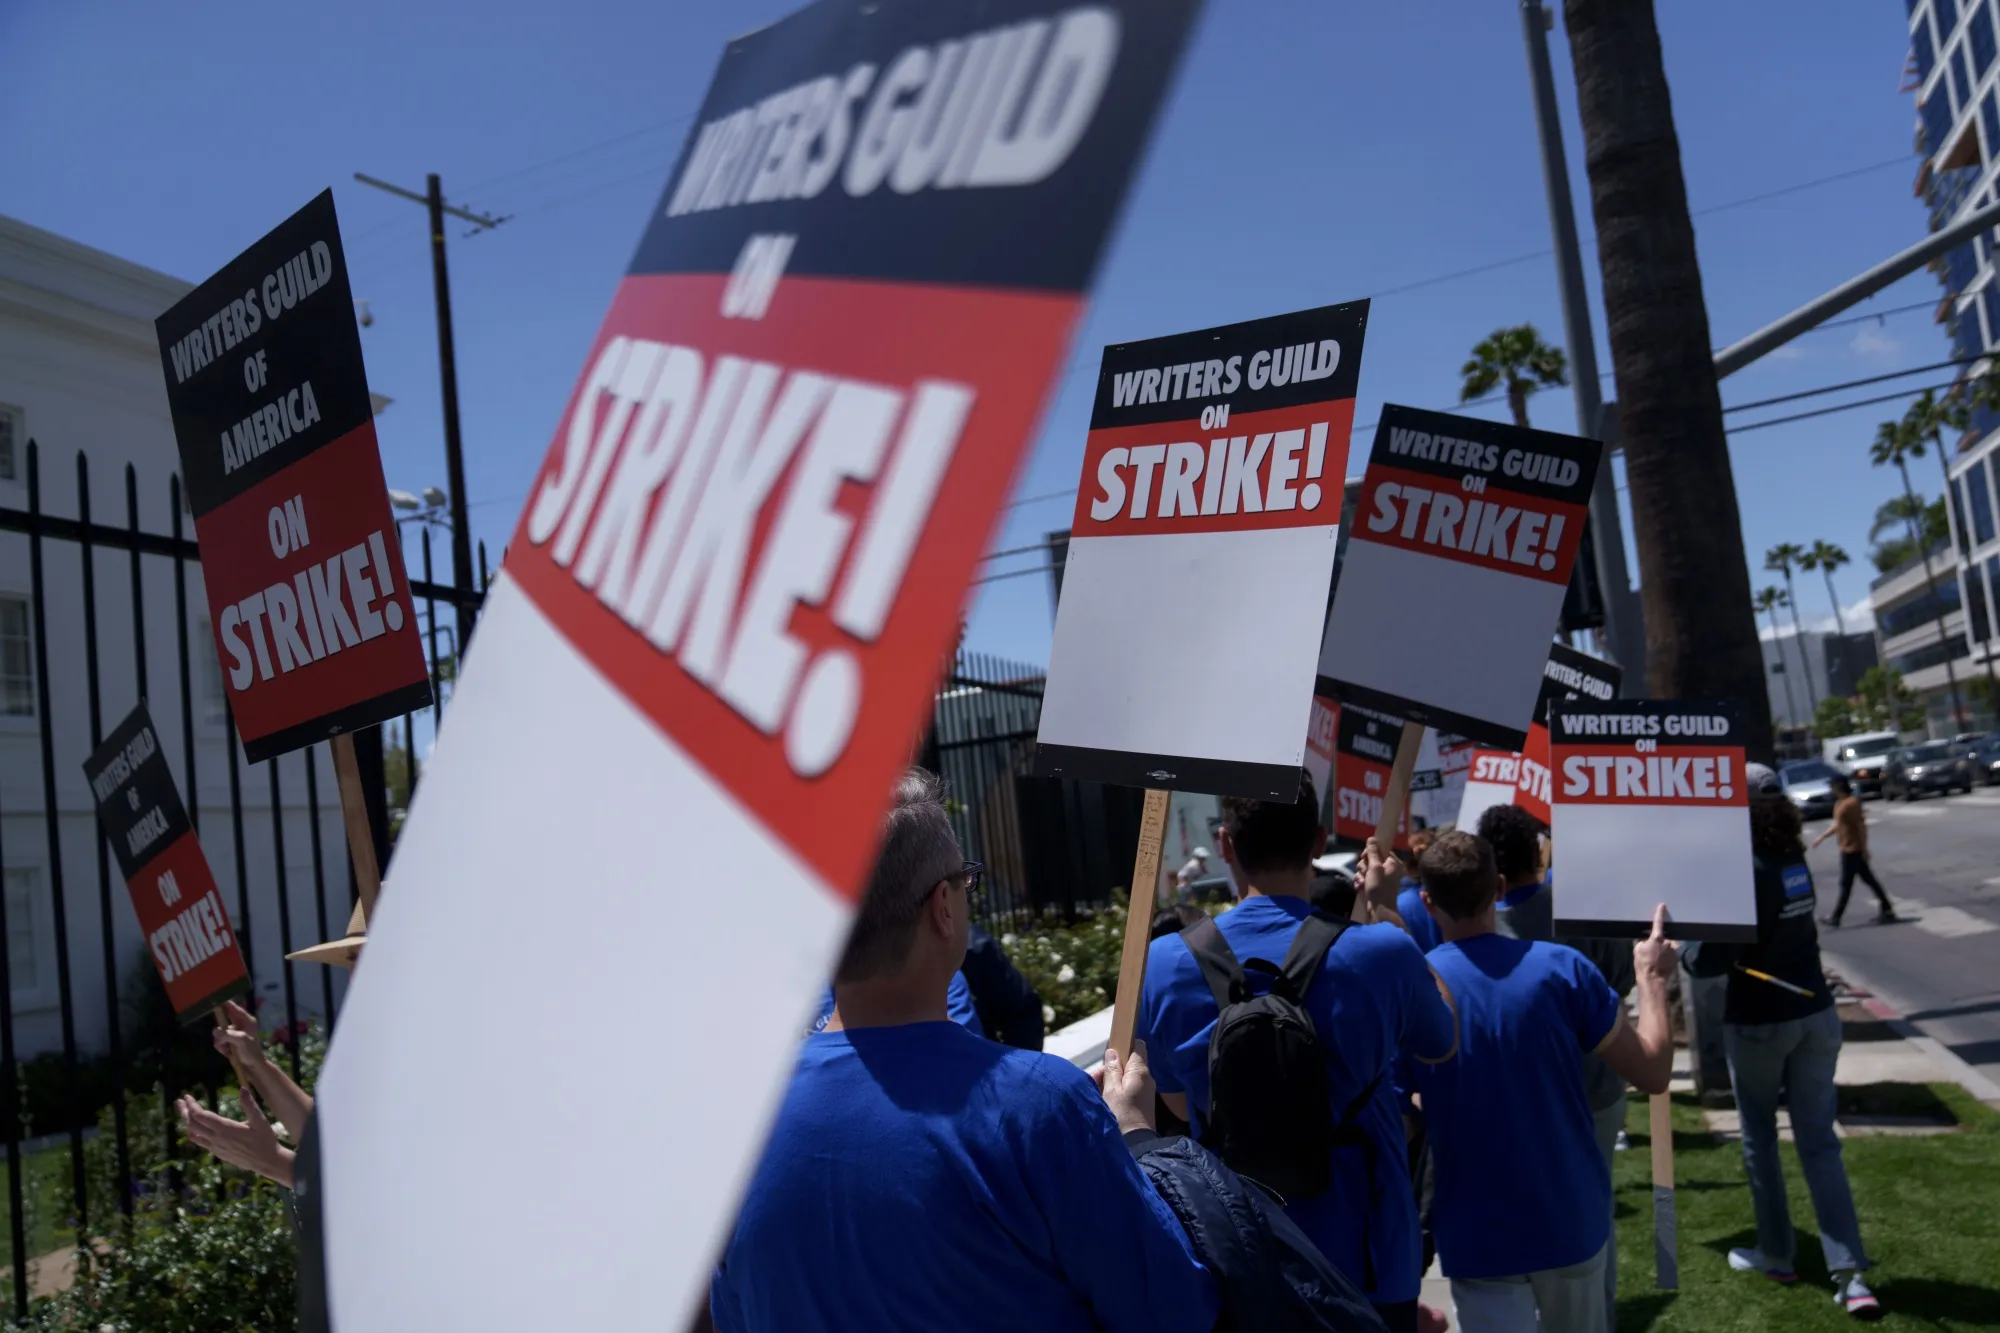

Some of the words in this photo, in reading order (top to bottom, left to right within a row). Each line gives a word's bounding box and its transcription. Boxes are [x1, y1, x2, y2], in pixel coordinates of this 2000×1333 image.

[666, 63, 877, 218] WRITERS
[842, 6, 1121, 197] GUILD
[720, 234, 797, 319] ON
[170, 288, 262, 384] WRITERS
[262, 240, 332, 320] GUILD
[244, 349, 268, 393] OF
[1112, 355, 1242, 408] WRITERS
[1248, 339, 1340, 391] GUILD
[220, 380, 321, 475] AMERICA
[1200, 404, 1230, 431] ON
[1090, 421, 1329, 522] STRIKE!
[1388, 426, 1499, 472] WRITERS
[1502, 448, 1580, 487] GUILD
[1461, 473, 1487, 495] ON
[268, 494, 310, 560] ON
[1367, 481, 1566, 572] STRIKE!
[526, 334, 977, 779] STRIKE!
[220, 530, 404, 691] STRIKE!
[1582, 674, 1613, 700] GUILD
[1352, 734, 1393, 760] AMERICA
[1560, 714, 1661, 735] WRITERS
[1664, 715, 1729, 736] GUILD
[1635, 738, 1657, 752] ON
[1364, 770, 1381, 790] ON
[1473, 756, 1519, 782] STRI
[1562, 755, 1734, 799] STRIKE!
[126, 804, 170, 858] AMERICA
[157, 869, 182, 907] ON
[149, 890, 231, 983] STRIKE!
